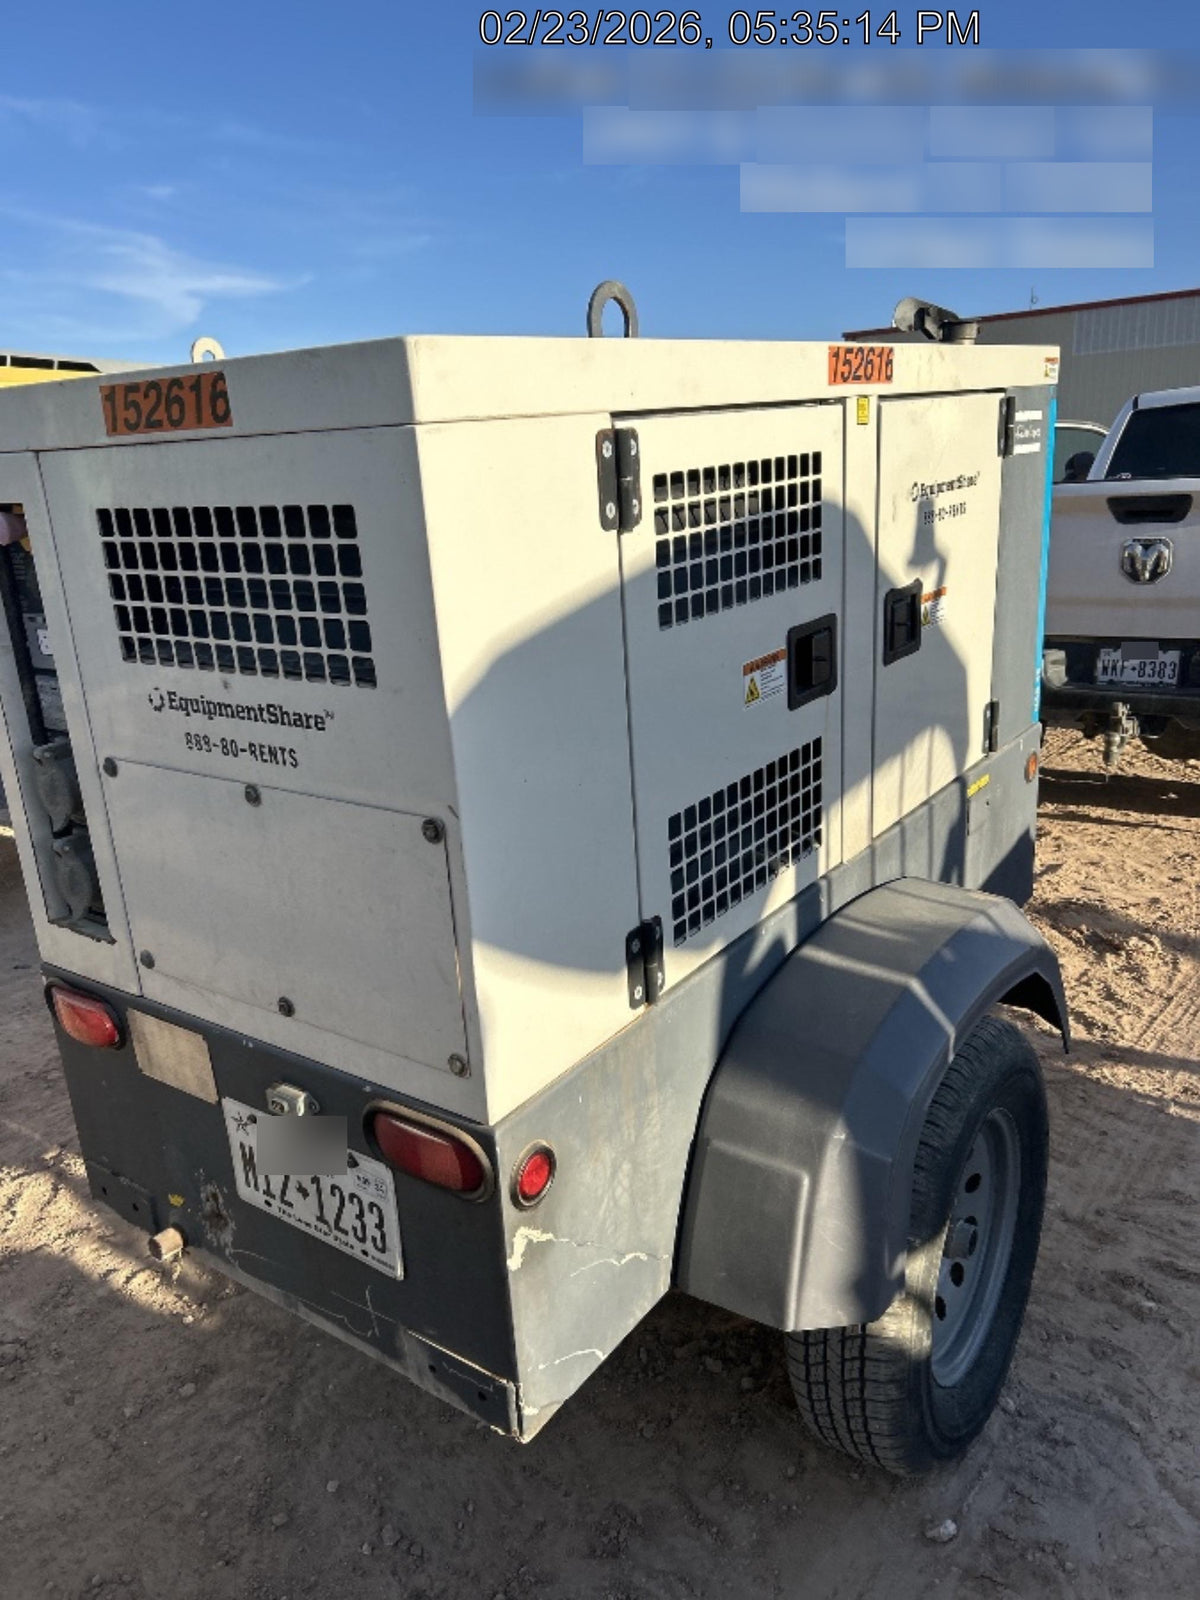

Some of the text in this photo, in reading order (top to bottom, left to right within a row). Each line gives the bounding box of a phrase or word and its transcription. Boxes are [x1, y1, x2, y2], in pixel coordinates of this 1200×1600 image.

[831, 345, 894, 383] 152616
[104, 371, 230, 433] 152616
[166, 690, 327, 732] EquipmentShare
[184, 732, 299, 768] 888-80-RENTS
